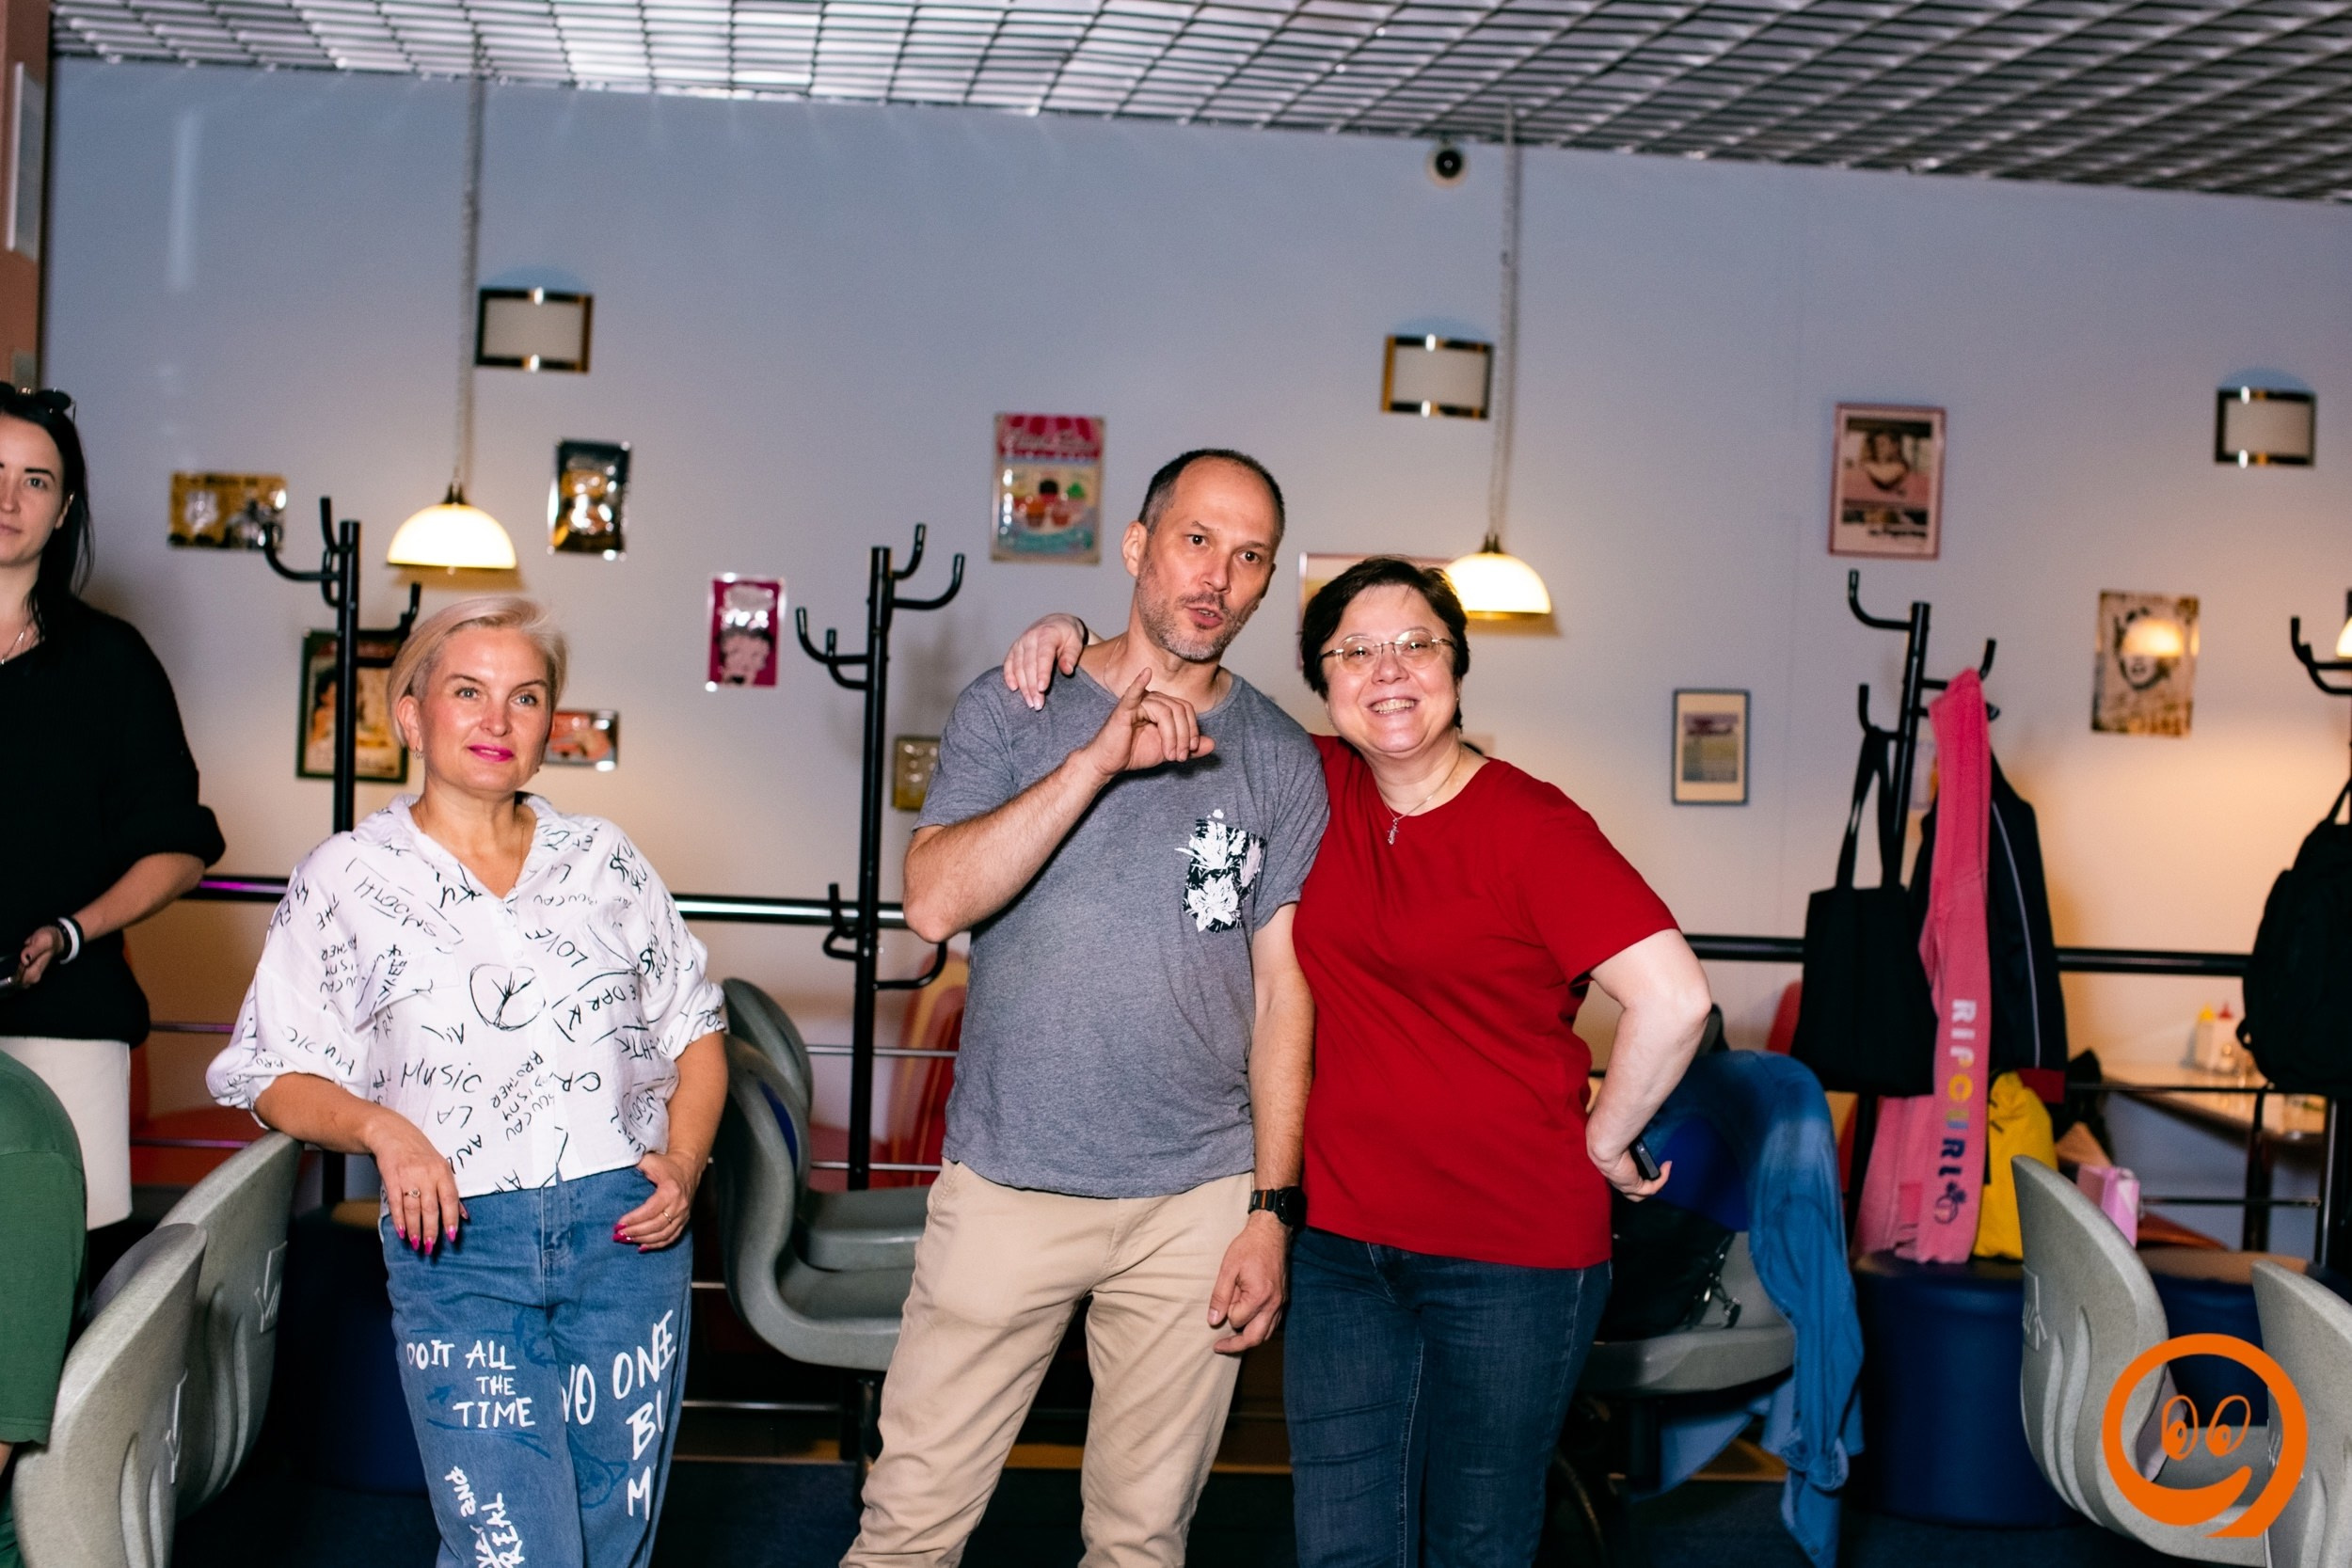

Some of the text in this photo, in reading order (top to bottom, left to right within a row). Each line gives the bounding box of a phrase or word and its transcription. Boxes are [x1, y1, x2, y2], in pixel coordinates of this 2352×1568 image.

[401, 1058, 483, 1093] MUSIC
[465, 1339, 516, 1370] ALL
[612, 1309, 676, 1401] ONE
[476, 1374, 516, 1396] THE
[453, 1398, 536, 1429] TIME
